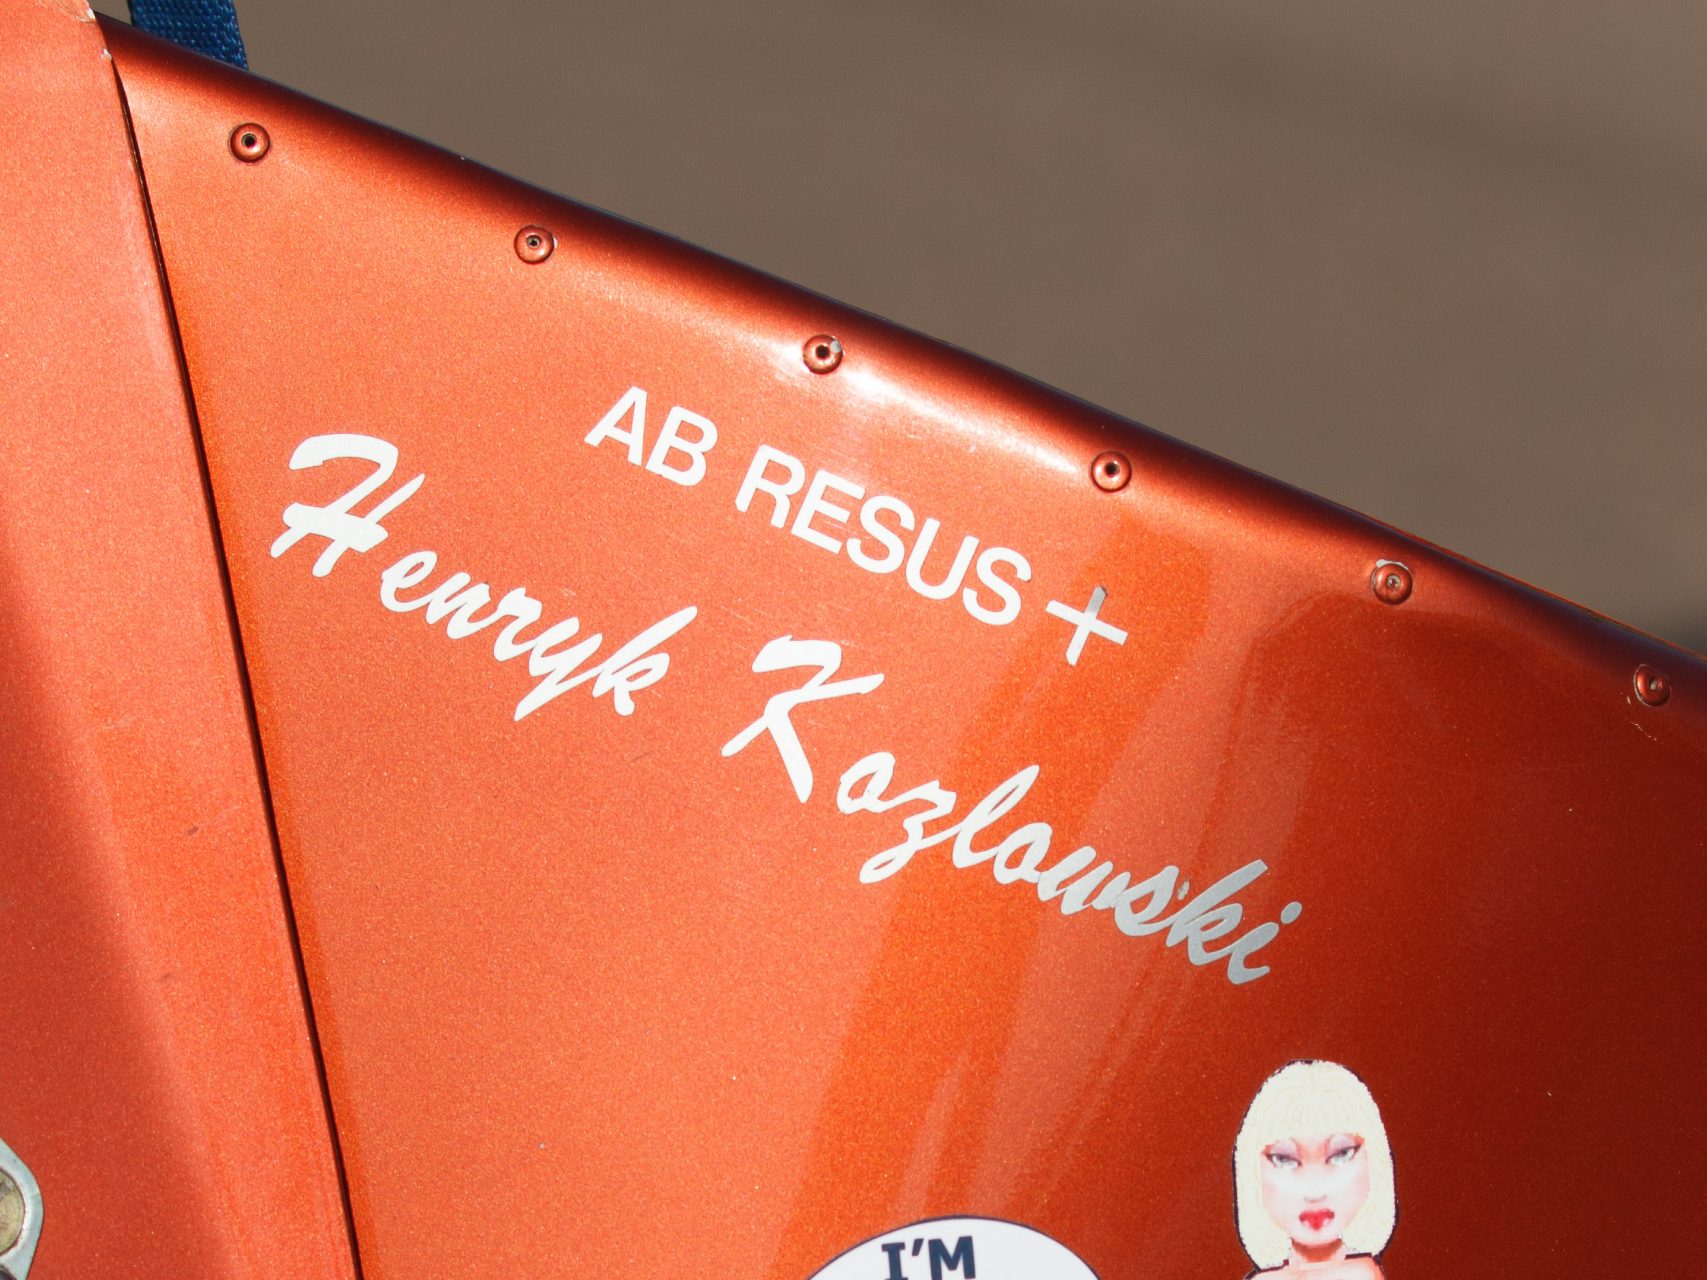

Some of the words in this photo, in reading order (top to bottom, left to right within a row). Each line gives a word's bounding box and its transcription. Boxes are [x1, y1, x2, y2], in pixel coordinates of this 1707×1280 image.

[584, 386, 719, 488] AB
[735, 443, 1032, 628] RESUS
[268, 433, 698, 722] Henryk
[721, 634, 1304, 986] Kozlowski
